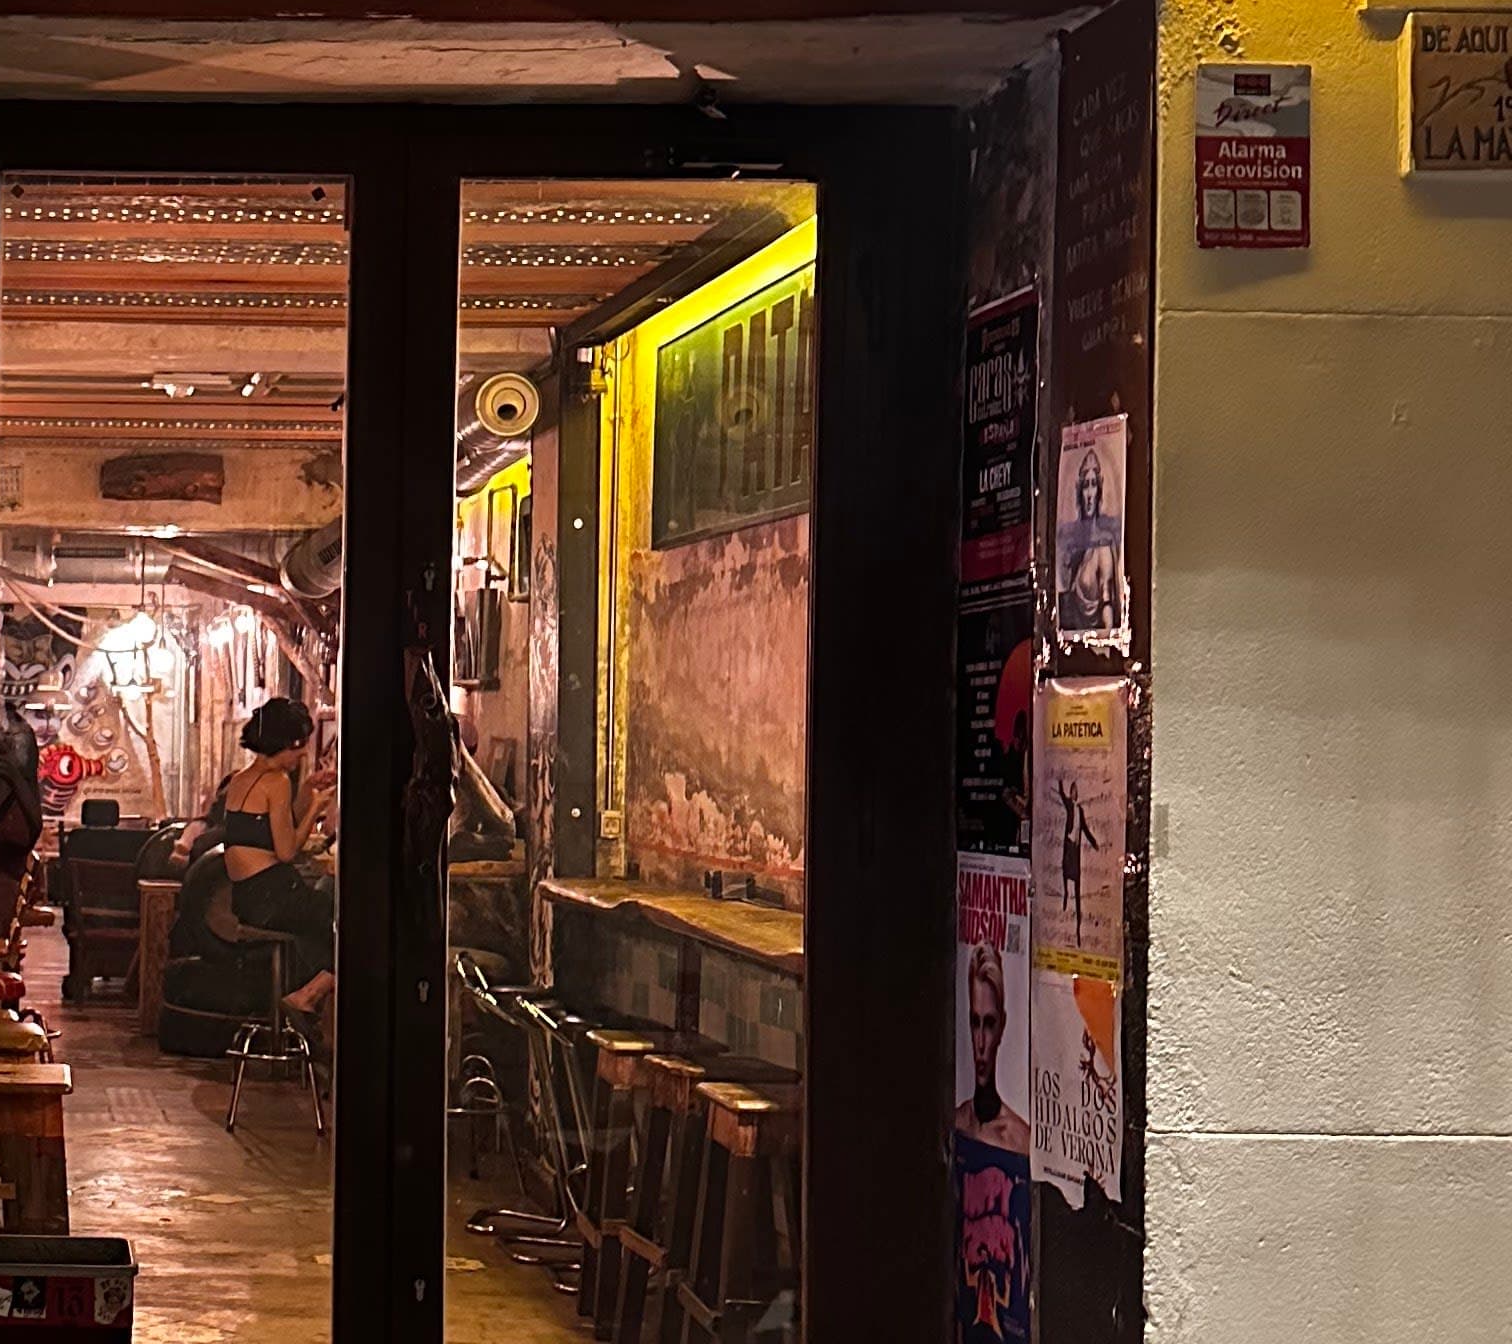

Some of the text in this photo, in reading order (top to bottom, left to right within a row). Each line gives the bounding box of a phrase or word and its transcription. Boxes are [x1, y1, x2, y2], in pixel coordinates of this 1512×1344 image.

[1421, 25, 1509, 54] DE AQUI
[1218, 140, 1287, 160] Alarma
[1424, 125, 1466, 160] LA
[1202, 160, 1303, 180] Zerovision
[1052, 720, 1103, 739] LA PATÉTICA
[958, 870, 1028, 917] SAMANTHA
[1034, 1067, 1117, 1115] LOS DOS
[1035, 1098, 1117, 1144] HIDALGOS
[1035, 1124, 1116, 1175] DE VERONA
